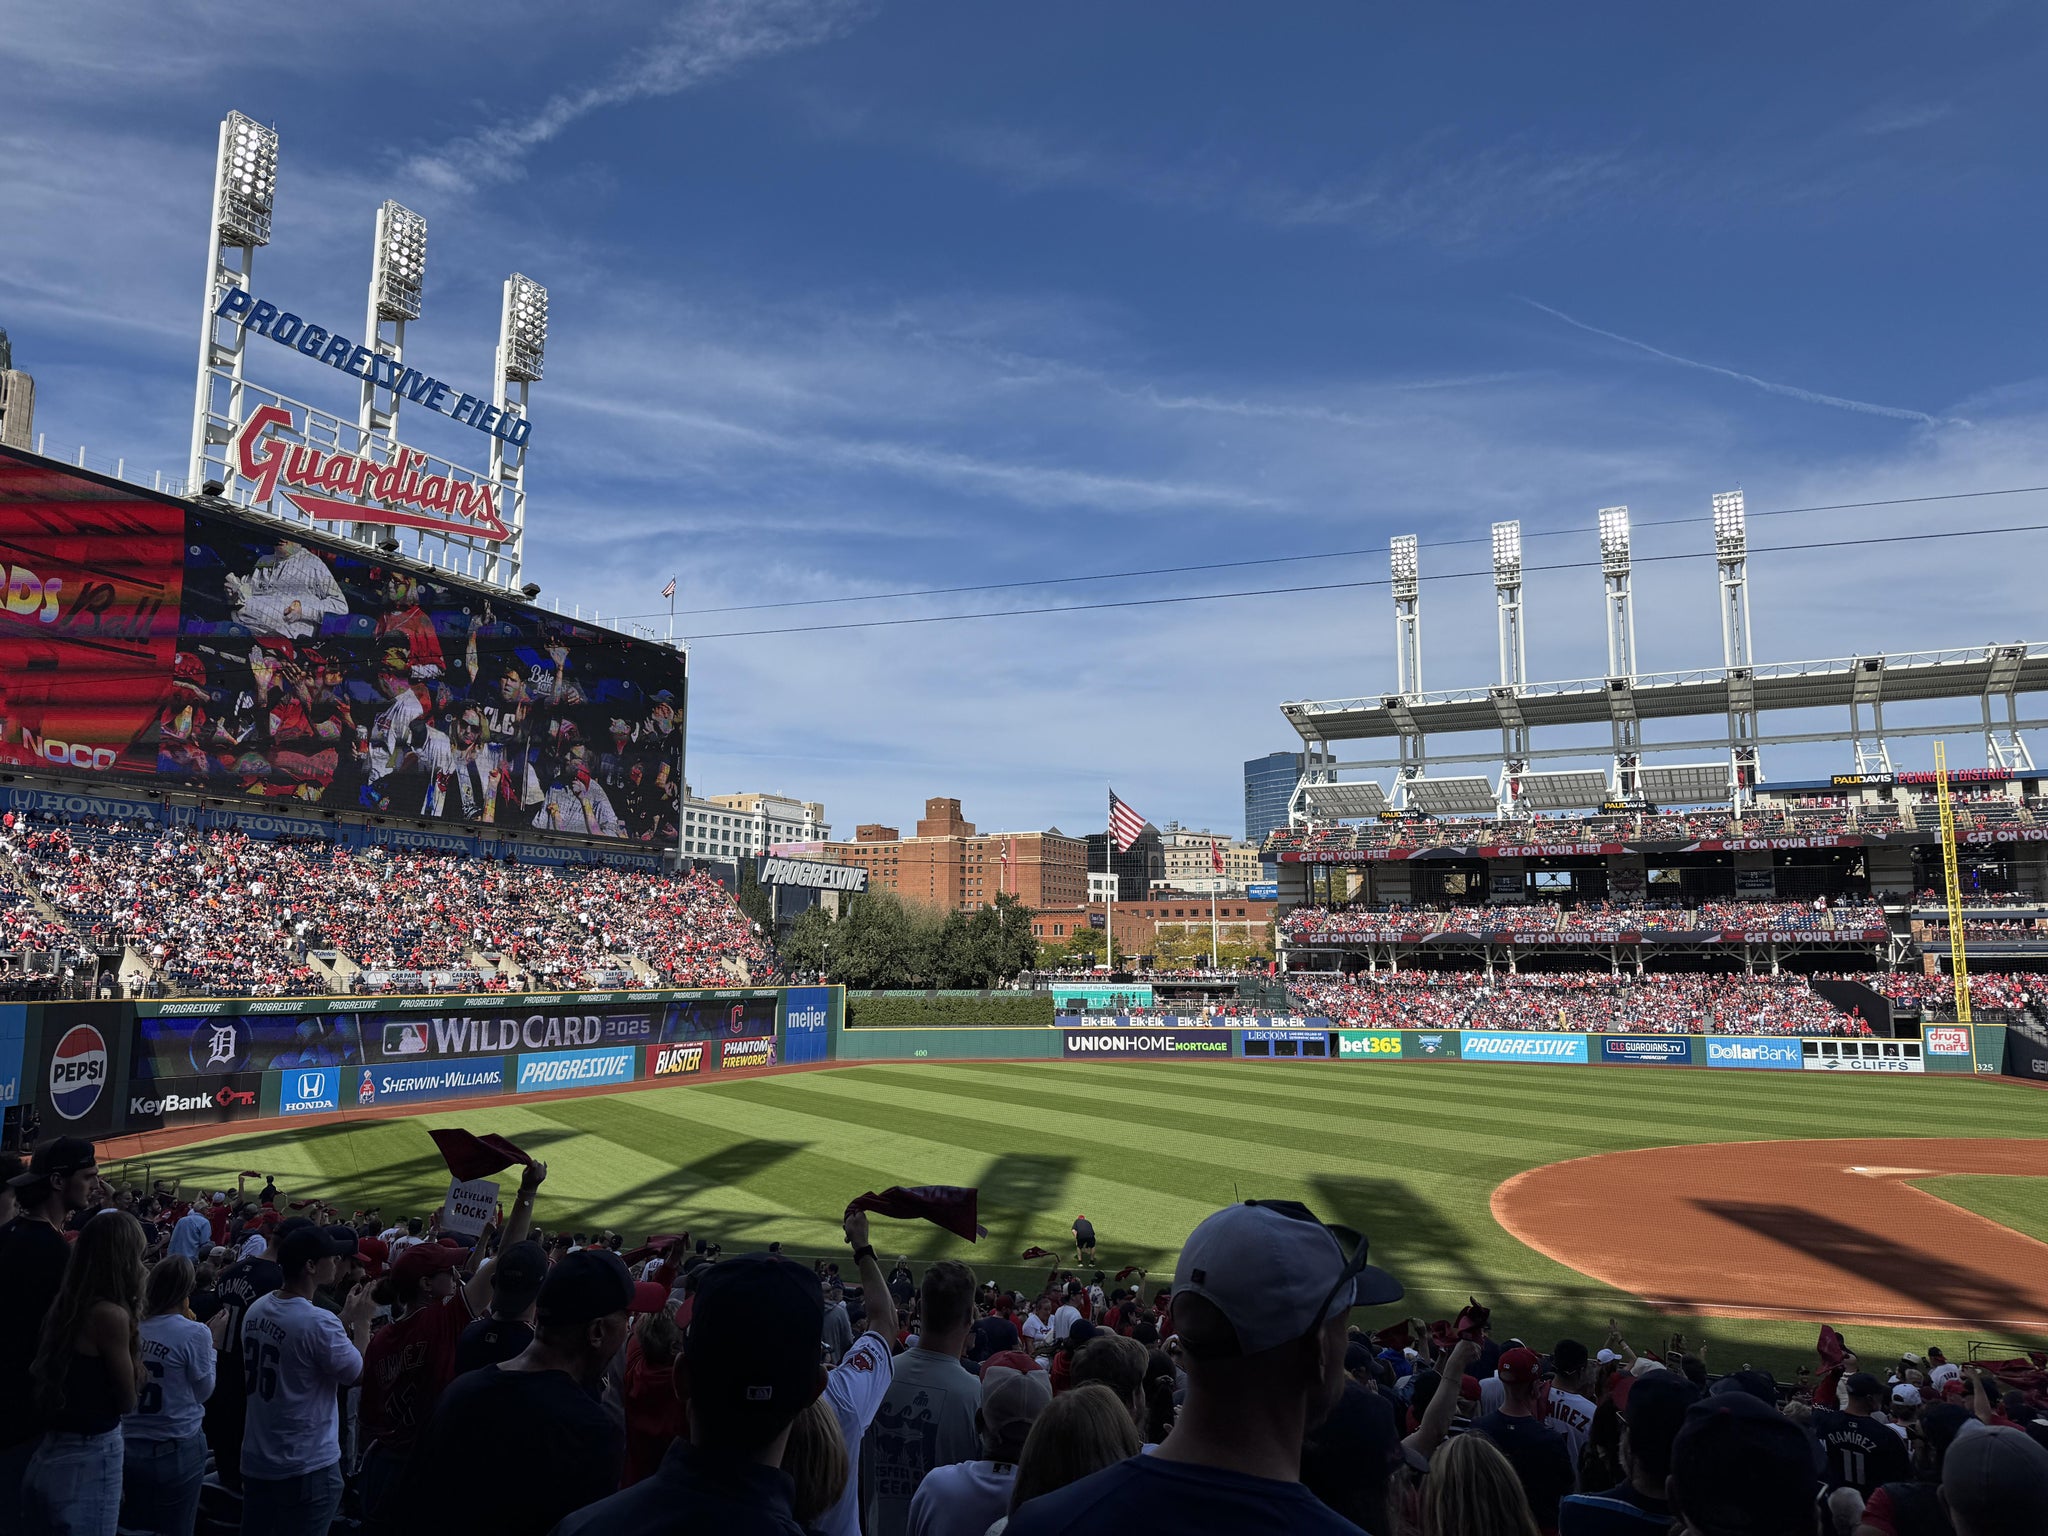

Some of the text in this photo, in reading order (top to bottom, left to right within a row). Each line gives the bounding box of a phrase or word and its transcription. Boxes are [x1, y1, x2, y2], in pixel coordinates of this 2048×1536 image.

[214, 286, 534, 448] PROGRESSIVE FIELD
[236, 403, 508, 530] Guardians
[22, 727, 117, 771] NOCO
[1958, 767, 2015, 781] DISTRICT
[39, 794, 155, 819] HONDA
[235, 815, 326, 837] HONDA
[393, 832, 469, 851] HONDA
[1722, 835, 1839, 850] GET ON YOUR FEET
[1967, 832, 1993, 843] GET
[1997, 831, 2018, 842] ON
[521, 845, 583, 862] HONDA
[1299, 849, 1390, 862] GET ON YOUR FEET
[1498, 843, 1602, 857] GET ON YOUR FEET
[602, 853, 658, 868] HONDA
[761, 858, 869, 891] PROGRESSIVE
[1309, 932, 1402, 943] GET ON YOUR FEET
[1514, 932, 1620, 943] GET ON YOUR FEET
[1744, 930, 1864, 943] GET ON YOUR FEET
[464, 998, 505, 1006] PROGRESSIVE
[523, 996, 562, 1004] PROGRESSIVE
[577, 994, 613, 1002] PROGRESSIVE
[627, 993, 659, 1001] PROGRESSIVE
[673, 991, 702, 1000] PROGRESSIVE
[160, 1004, 222, 1014] PROGRESSIVE
[249, 1002, 304, 1012] PROGRESSIVE
[328, 1000, 378, 1010] PROGRESSIVE
[400, 999, 445, 1008] PROGRESSIVE
[730, 1005, 743, 1034] C
[788, 1006, 826, 1031] meijer
[605, 1020, 650, 1036] 2025
[1930, 1028, 1961, 1043] drug
[724, 1040, 768, 1055] PHANTOM
[1175, 1042, 1228, 1051] MORTGAGE
[1339, 1036, 1402, 1053] bet365
[1464, 1038, 1579, 1057] PROGRESSIVE
[1934, 1042, 1969, 1052] mart
[722, 1054, 767, 1068] FIREWORKS
[1851, 1060, 1909, 1070] CLIFFS
[1976, 1063, 1994, 1071] 325
[53, 1060, 104, 1083] PEPSI
[520, 1055, 628, 1085] PROGRESSIVE
[129, 1092, 213, 1116] KeyBank
[285, 1100, 334, 1111] HONDA
[454, 1203, 487, 1220] ROCKS
[245, 1337, 280, 1402] 36
[1828, 1430, 1877, 1453] RAMÍREZ
[1840, 1448, 1866, 1485] 11
